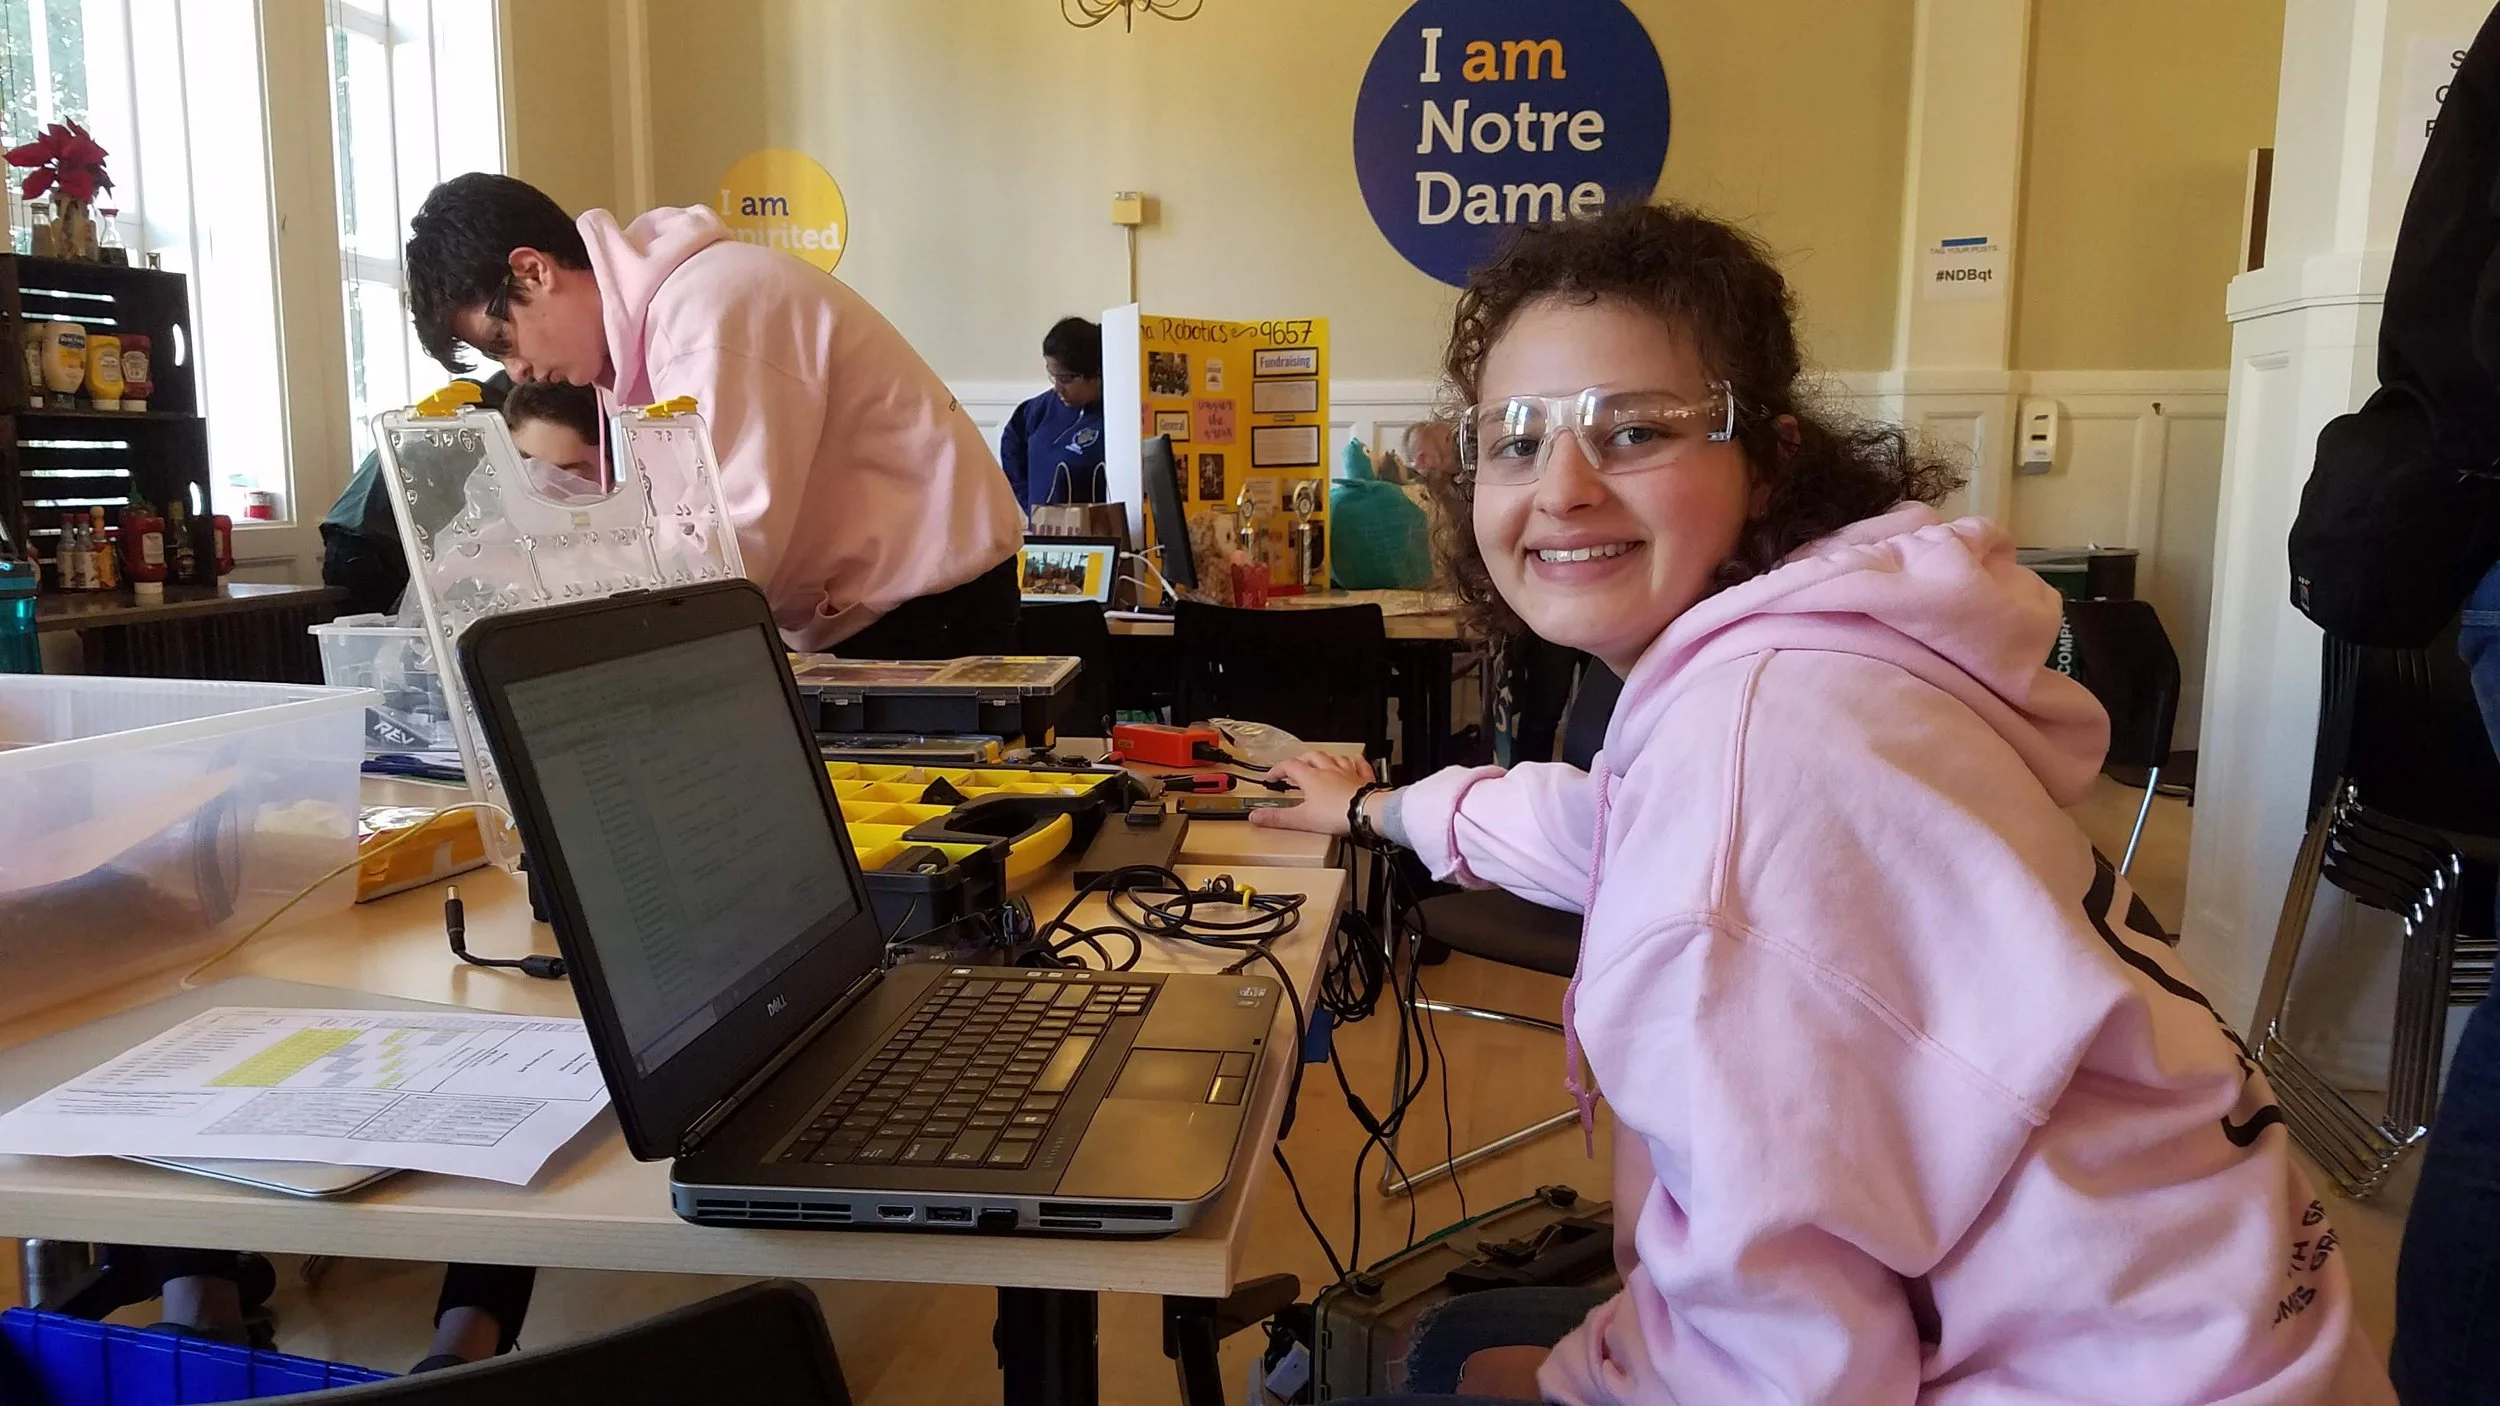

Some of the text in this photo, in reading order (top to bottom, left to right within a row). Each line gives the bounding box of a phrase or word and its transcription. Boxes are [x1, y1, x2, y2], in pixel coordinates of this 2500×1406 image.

[1419, 28, 1567, 83] I am
[1416, 99, 1605, 154] Notre
[720, 189, 789, 217] I am
[1415, 171, 1605, 225] Dame
[737, 221, 840, 250] pirited
[1936, 269, 1993, 283] #NDBqt
[1161, 318, 1229, 344] Robotics
[1260, 320, 1313, 345] 9657
[1260, 356, 1311, 369] Fundraising
[374, 720, 414, 744] REV
[767, 993, 788, 1017] DELL
